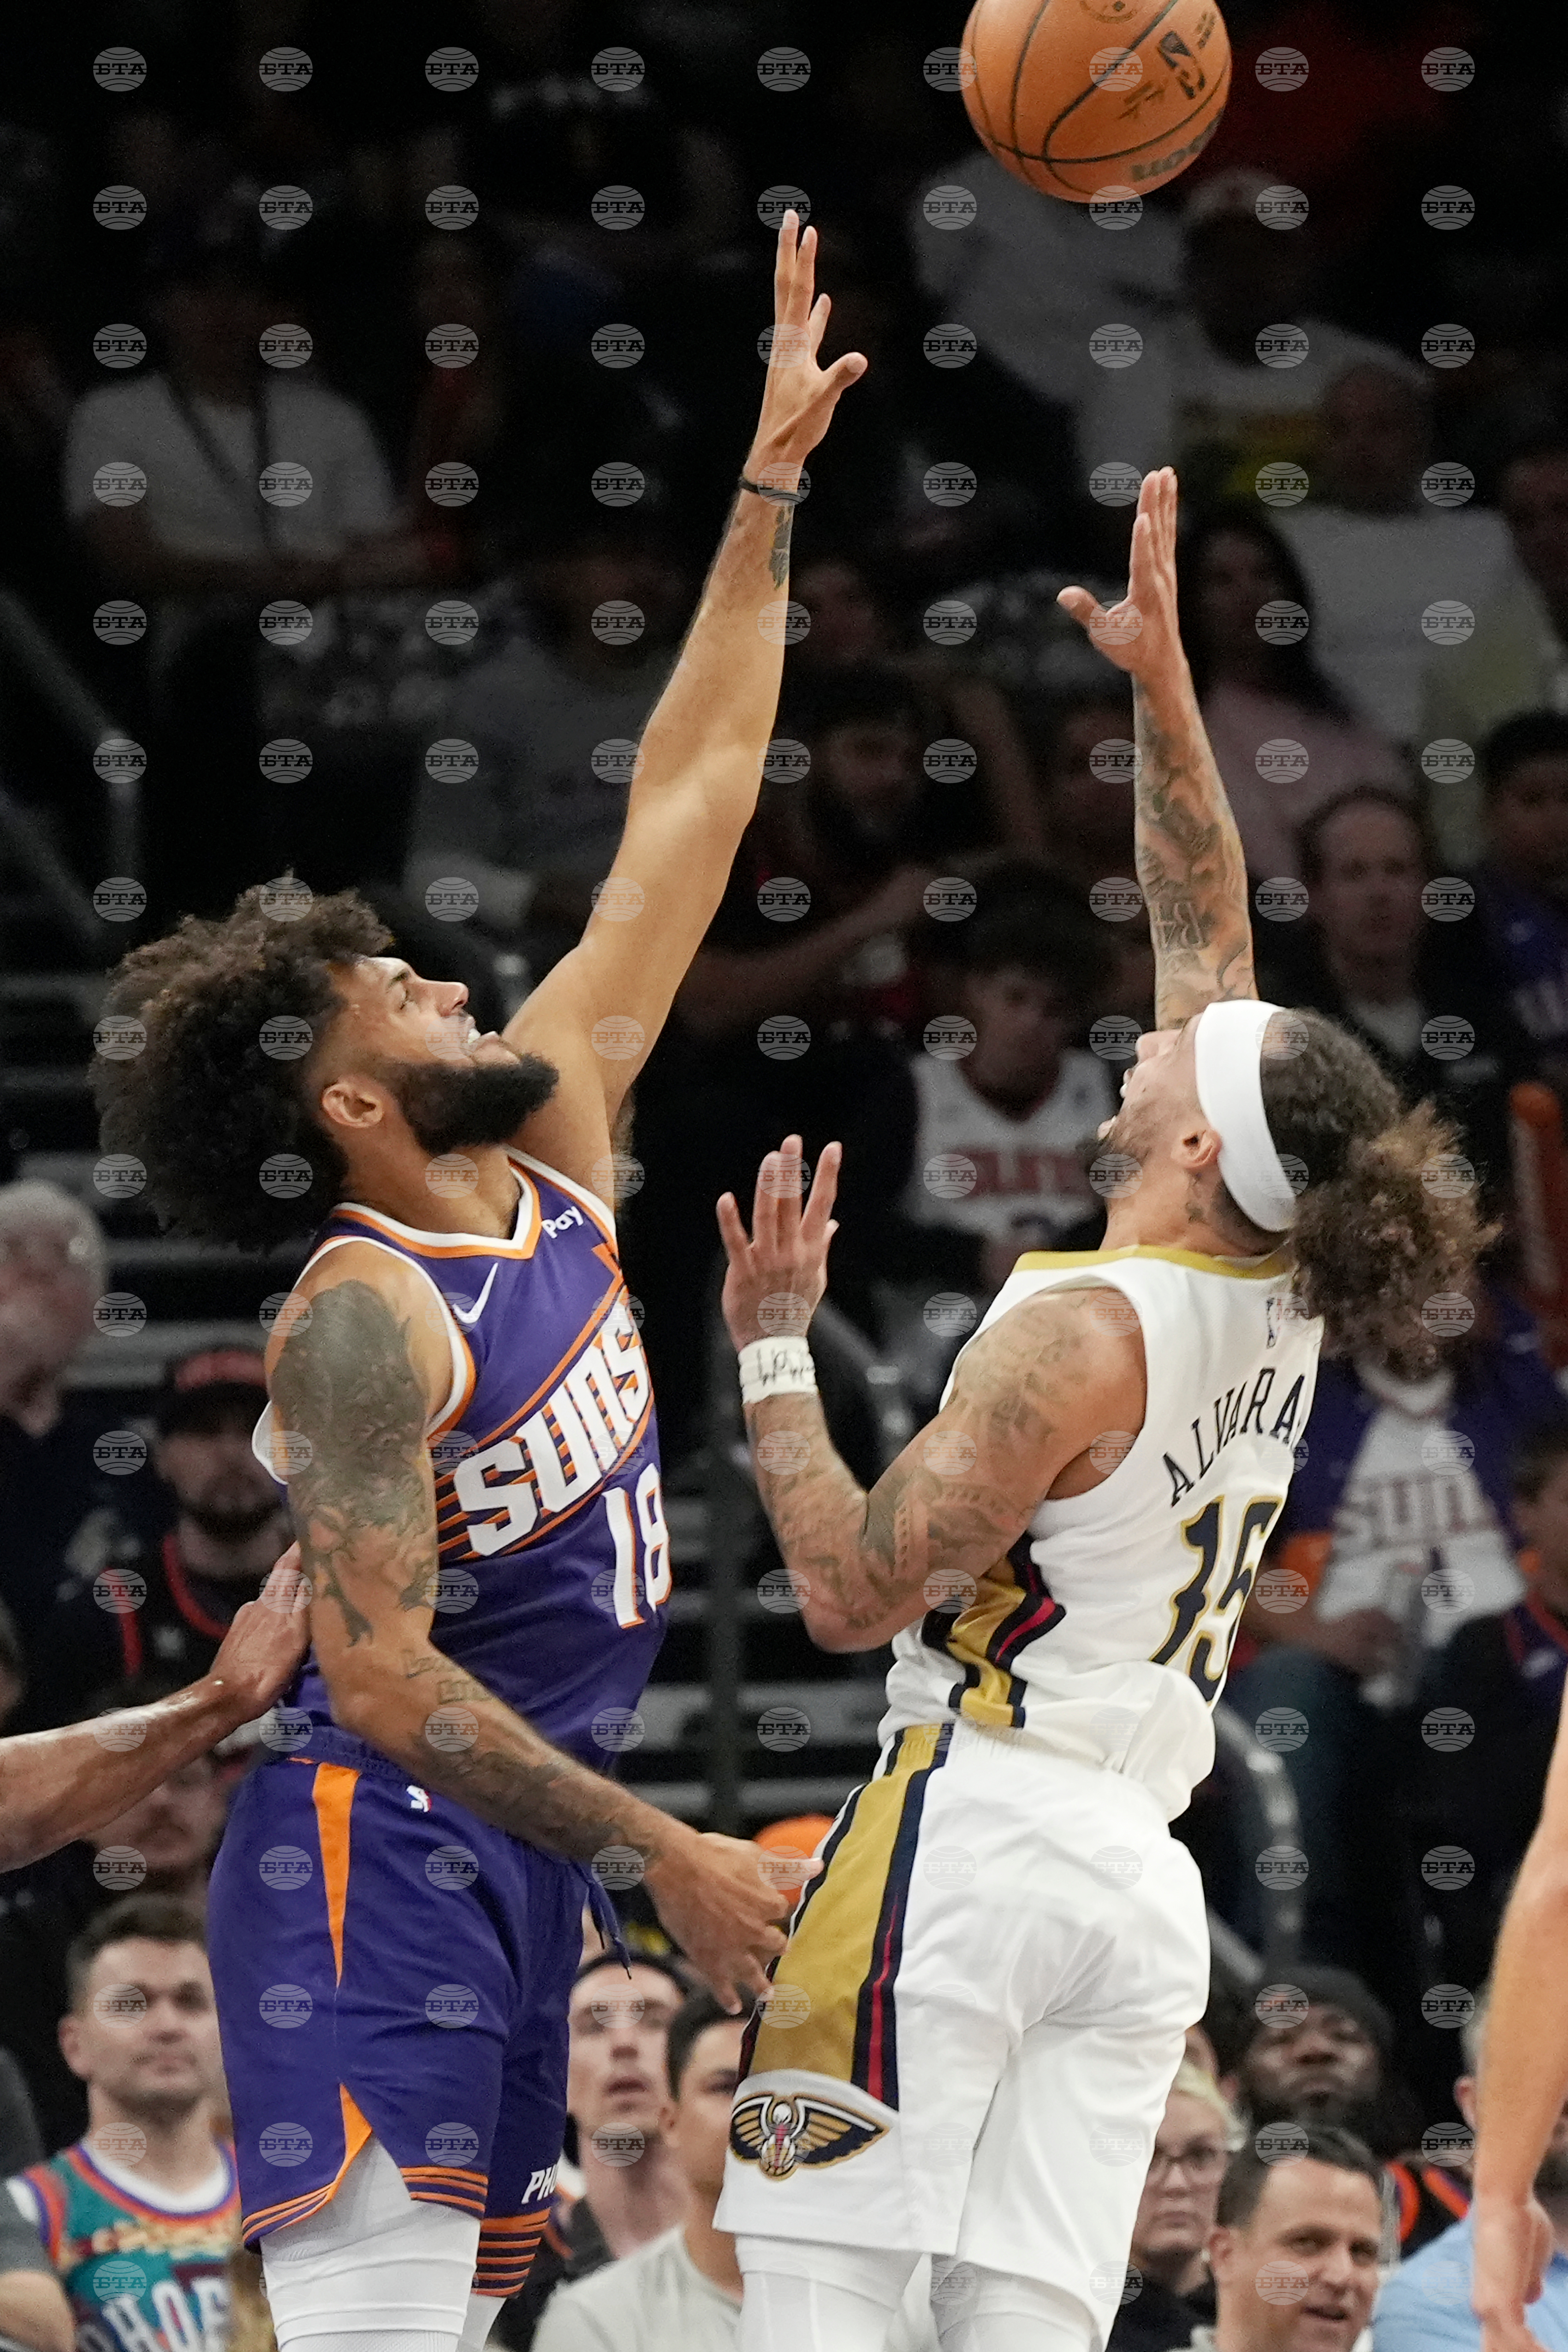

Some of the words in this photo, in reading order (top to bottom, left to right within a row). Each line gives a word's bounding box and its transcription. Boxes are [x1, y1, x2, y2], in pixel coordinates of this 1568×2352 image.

[541, 1206, 584, 1239] Pay
[454, 1300, 651, 1556] SUNS
[601, 1463, 672, 1629] 18
[1149, 1494, 1283, 1706] 15
[521, 2164, 558, 2204] PH
